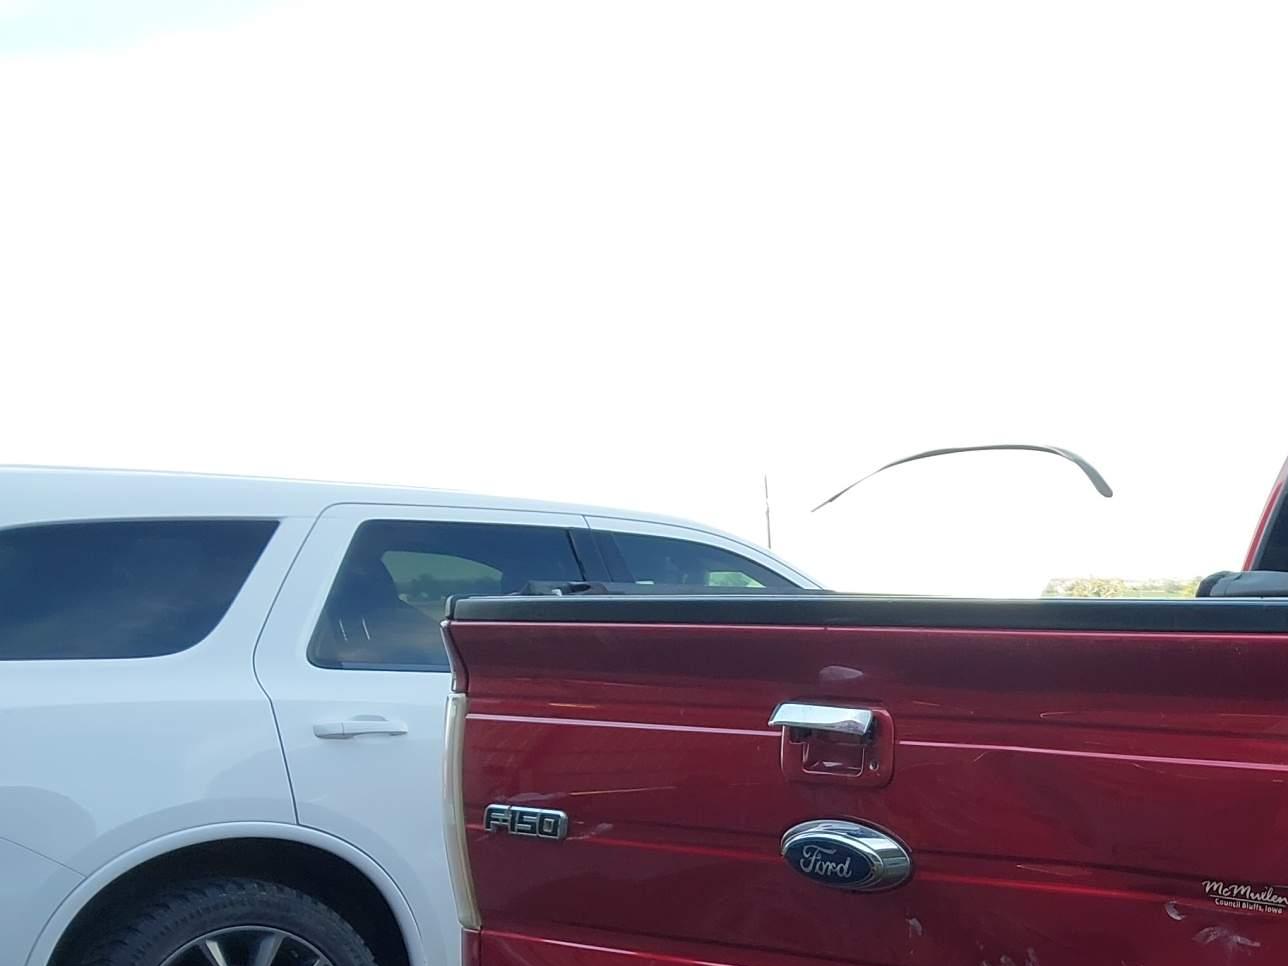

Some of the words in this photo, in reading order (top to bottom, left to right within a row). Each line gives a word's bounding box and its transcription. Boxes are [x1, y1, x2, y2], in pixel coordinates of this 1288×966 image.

[800, 844, 852, 878] Ford
[1215, 898, 1241, 909] Council
[1265, 904, 1283, 914] Iowa
